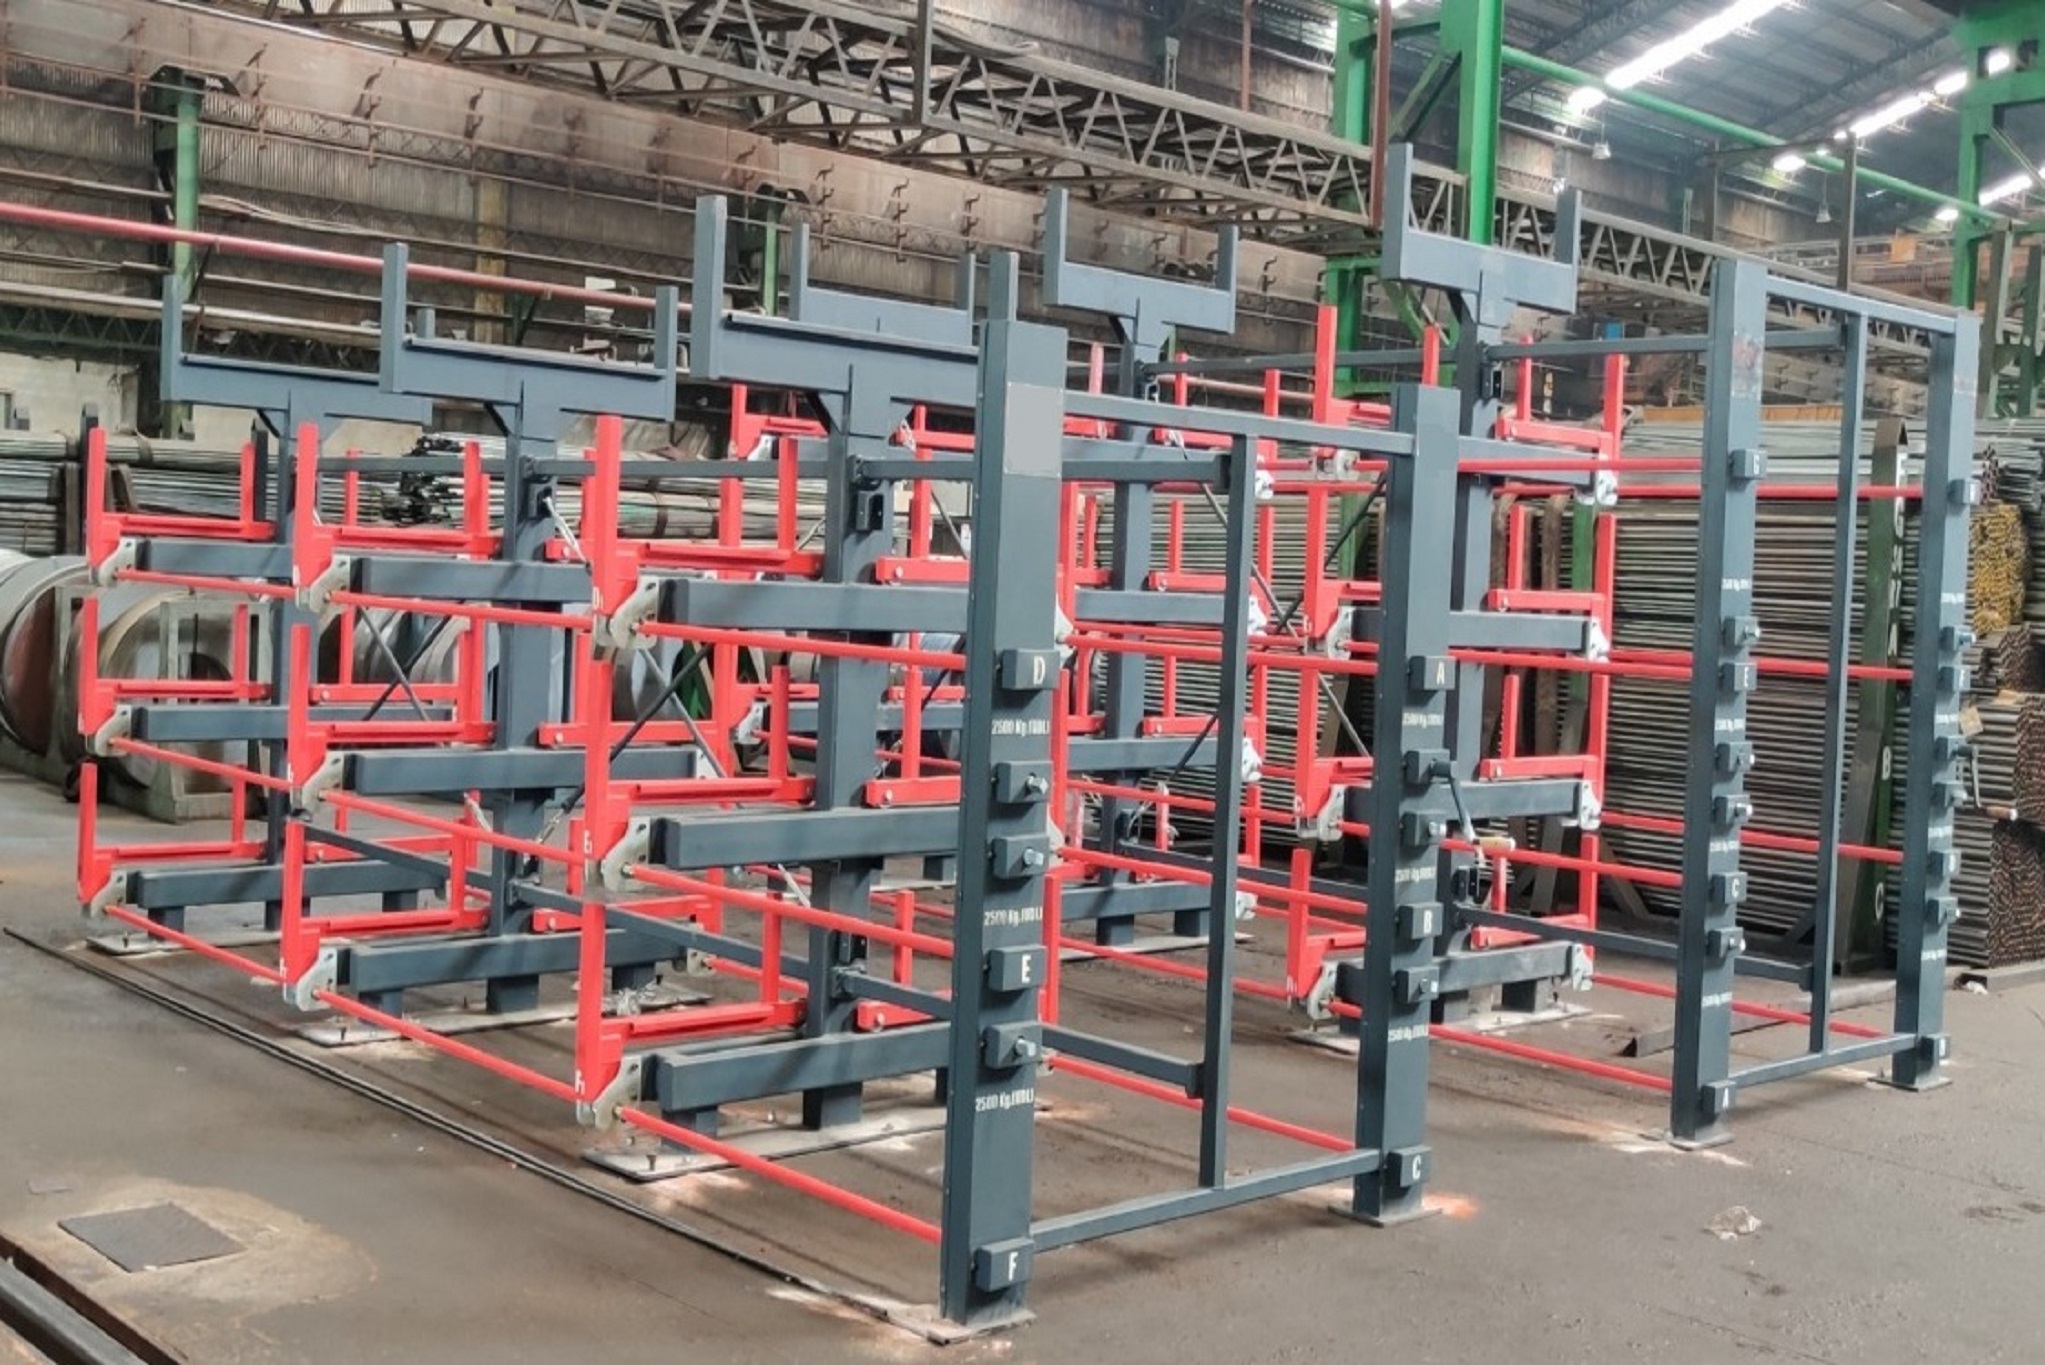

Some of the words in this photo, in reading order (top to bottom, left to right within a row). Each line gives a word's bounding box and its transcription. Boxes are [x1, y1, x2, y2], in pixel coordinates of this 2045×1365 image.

[1033, 655, 1046, 685] D
[1436, 661, 1445, 685] A
[991, 718, 1014, 735] 2500
[1731, 878, 1740, 899] C
[984, 909, 1007, 926] 2500
[1423, 909, 1433, 935] B
[1021, 954, 1031, 983] E
[975, 1093, 998, 1112] 2500
[1412, 1155, 1421, 1181] C
[1008, 1251, 1019, 1281] F
